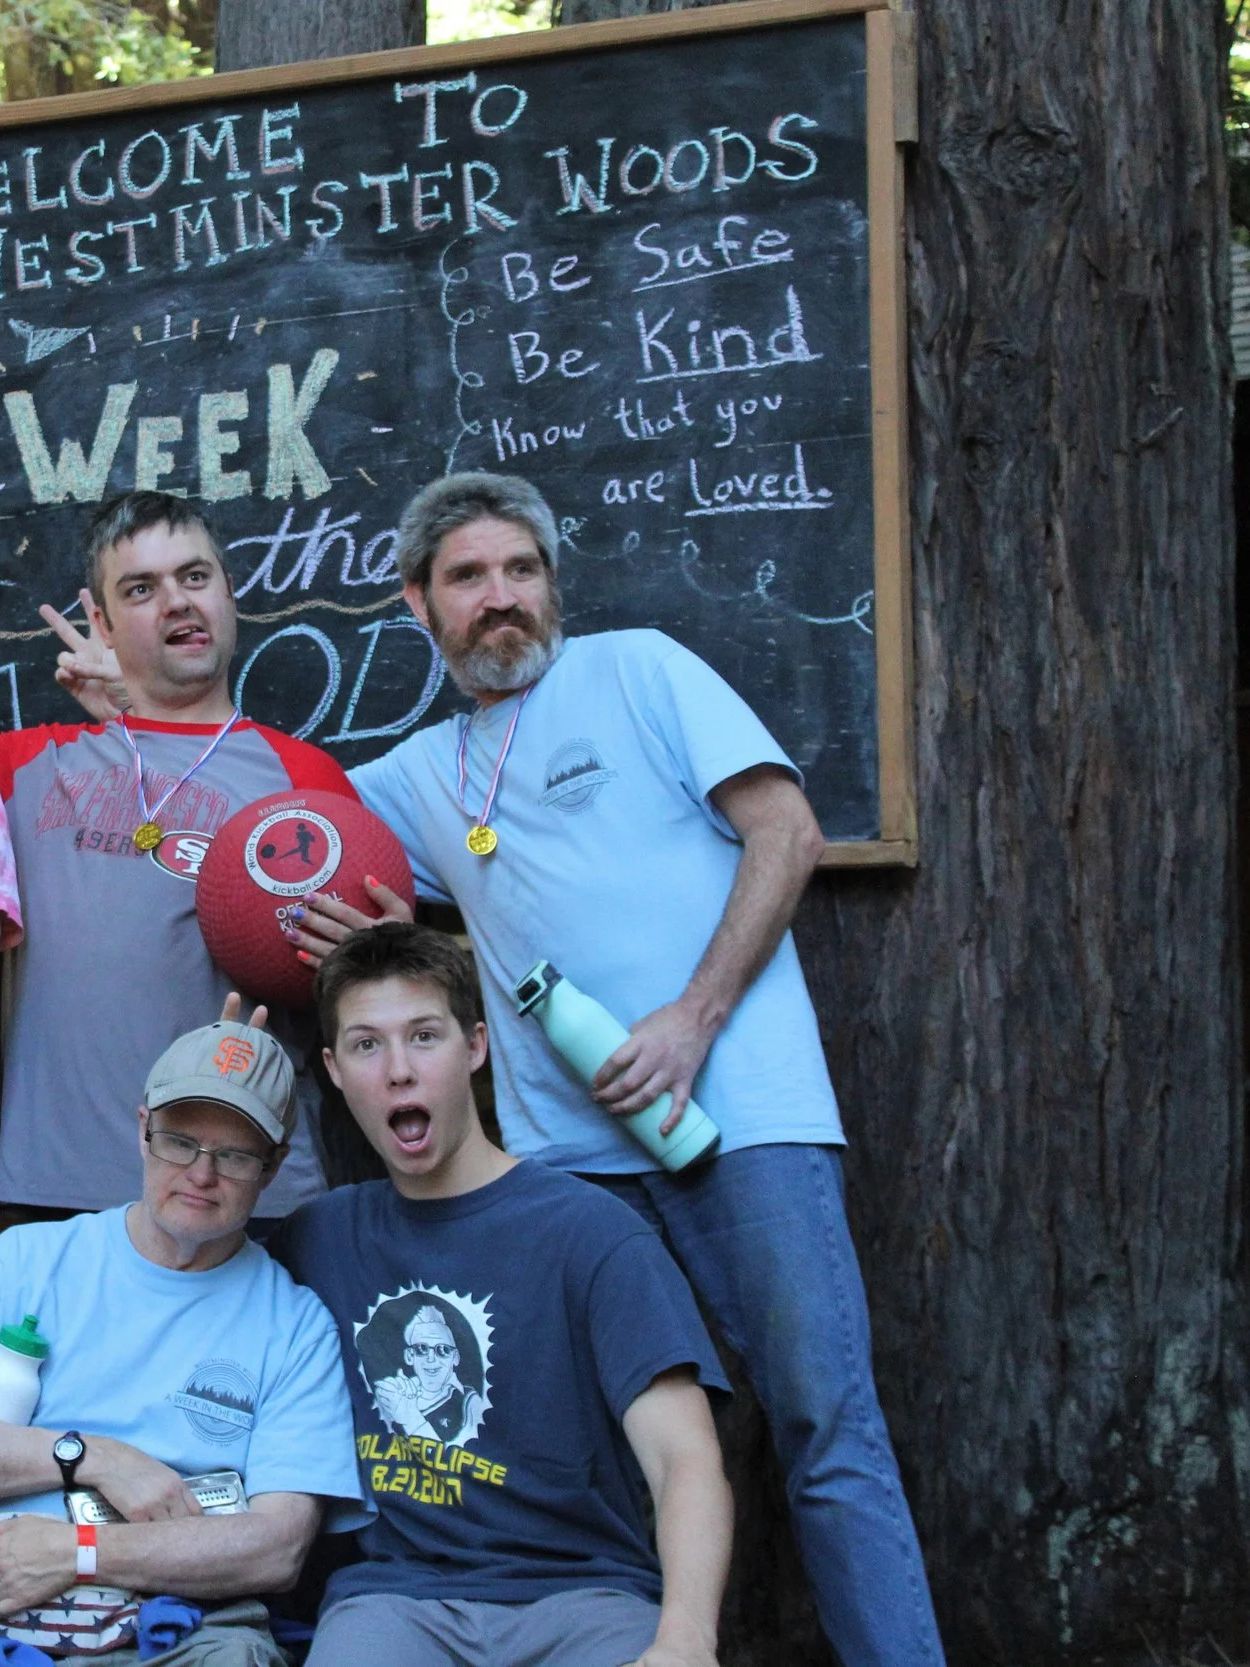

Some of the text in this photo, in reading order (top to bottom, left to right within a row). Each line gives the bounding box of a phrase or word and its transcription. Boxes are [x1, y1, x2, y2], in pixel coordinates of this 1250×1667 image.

[394, 71, 528, 148] TO
[544, 112, 820, 216] WOODS
[500, 215, 793, 303] Be Safe
[508, 284, 815, 385] Be Kind
[2, 347, 341, 504] WEEK
[614, 389, 695, 440] that
[714, 394, 782, 448] you
[602, 470, 667, 505] are
[202, 1402, 215, 1414] IN
